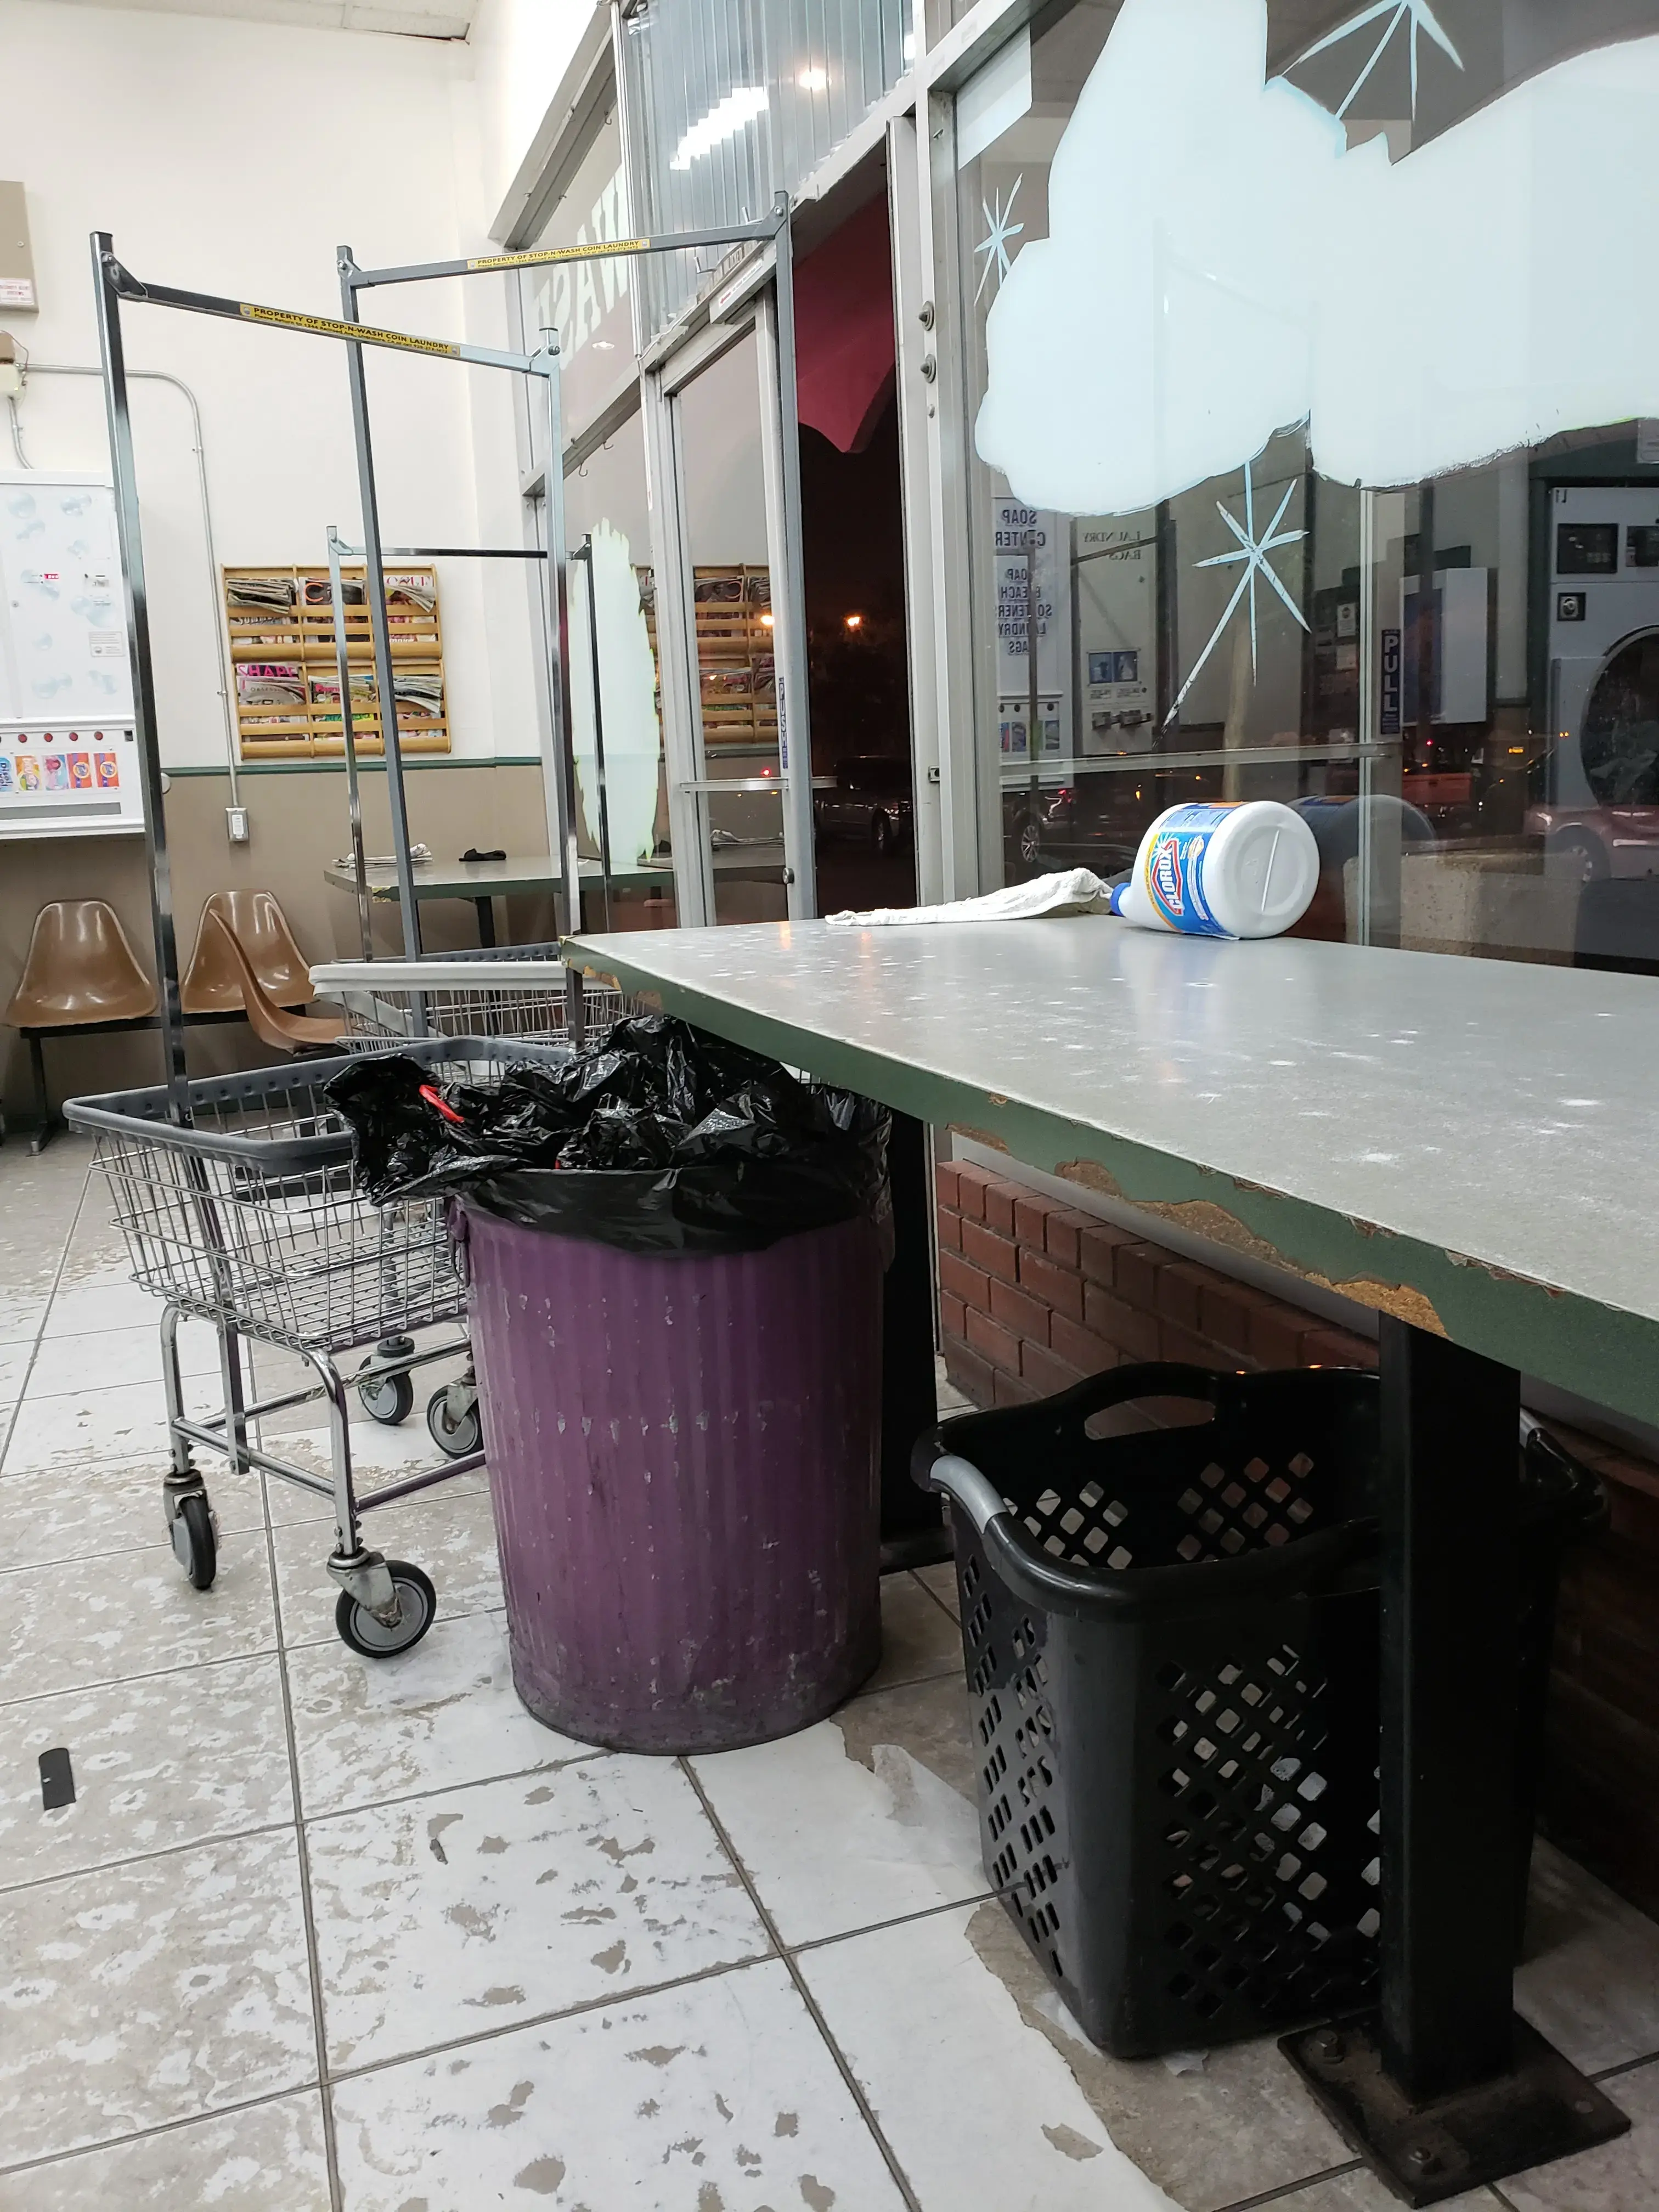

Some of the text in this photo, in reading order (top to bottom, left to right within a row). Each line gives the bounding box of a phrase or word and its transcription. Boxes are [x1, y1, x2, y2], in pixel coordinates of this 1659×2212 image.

[477, 256, 515, 264] PROPERTY
[529, 247, 580, 258] STOP-N-WASH
[603, 241, 639, 249] LAUNDRY
[253, 307, 303, 321] PROPERTY
[320, 321, 383, 338] STOP-N-WASH
[386, 333, 407, 342] COIN
[409, 337, 449, 349] LAUNDRY
[1384, 635, 1399, 712] PULL
[1159, 847, 1184, 909] CLOROX
